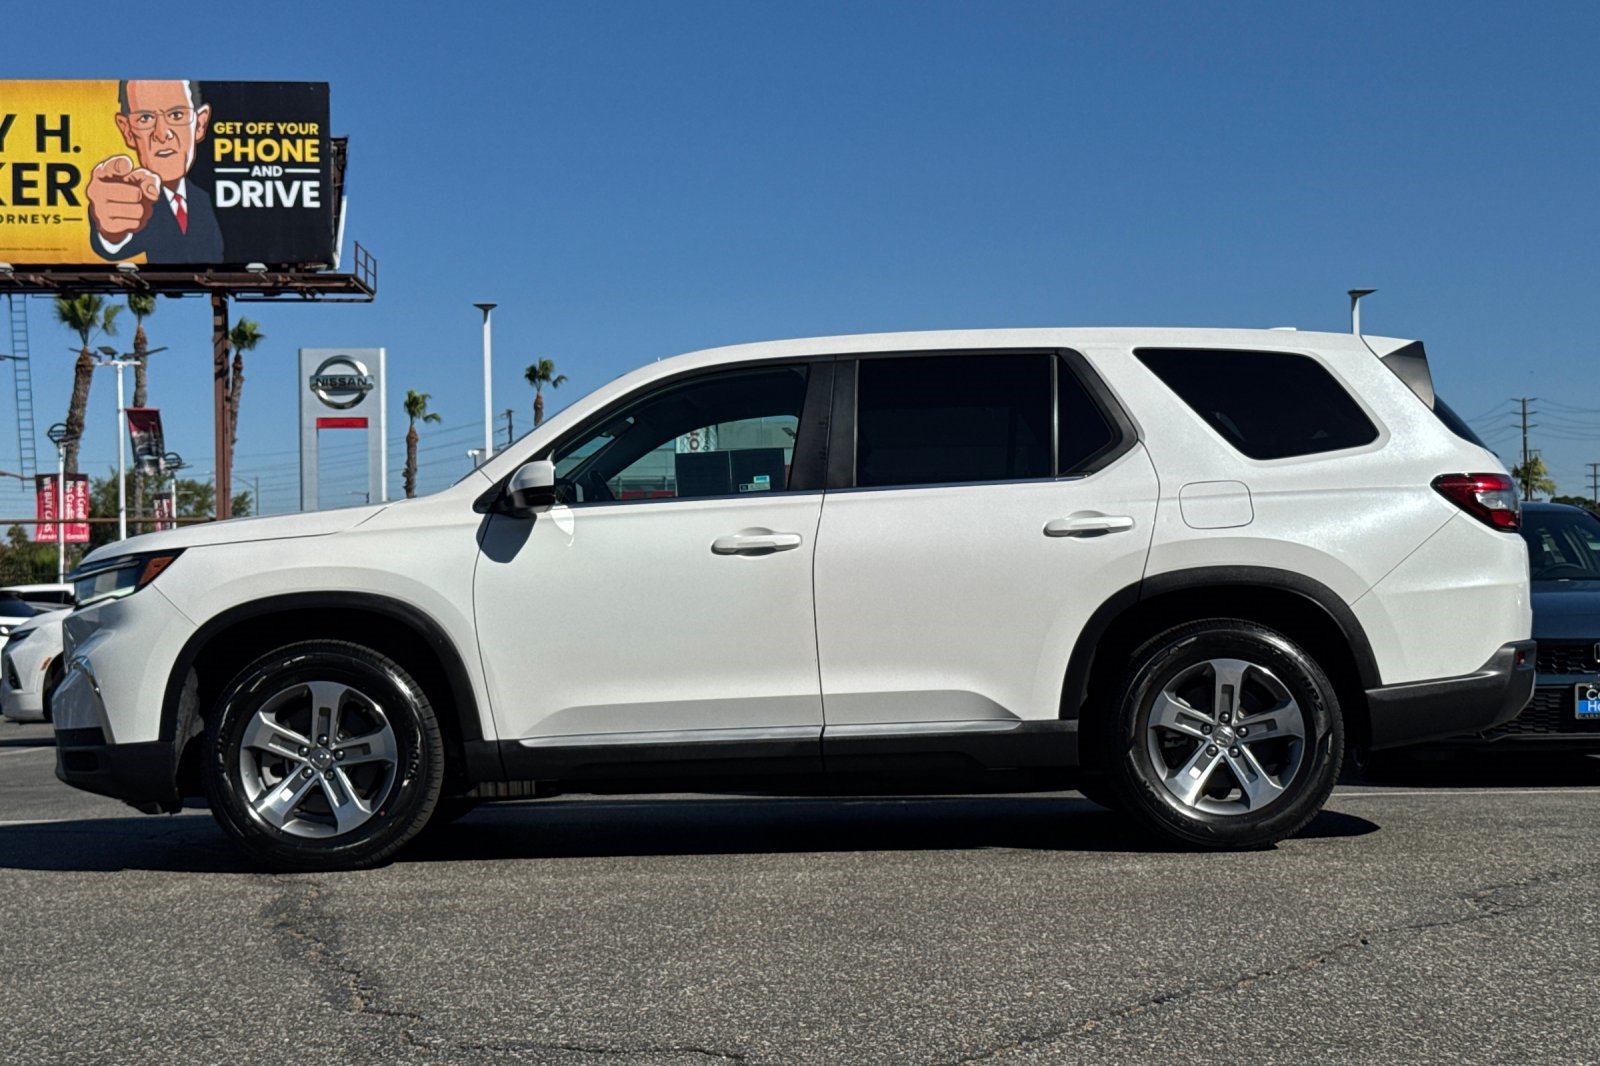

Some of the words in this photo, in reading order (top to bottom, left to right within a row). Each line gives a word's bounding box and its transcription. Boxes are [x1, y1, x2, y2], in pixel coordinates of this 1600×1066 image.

[36, 114, 82, 153] H.
[213, 122, 243, 135] GET
[245, 122, 275, 135] OFF
[276, 122, 319, 135] YOUR
[213, 138, 320, 163] PHONE
[0, 162, 82, 206] ER
[251, 165, 283, 178] AND
[215, 180, 321, 208] DRIVE
[315, 377, 368, 387] NISSAN
